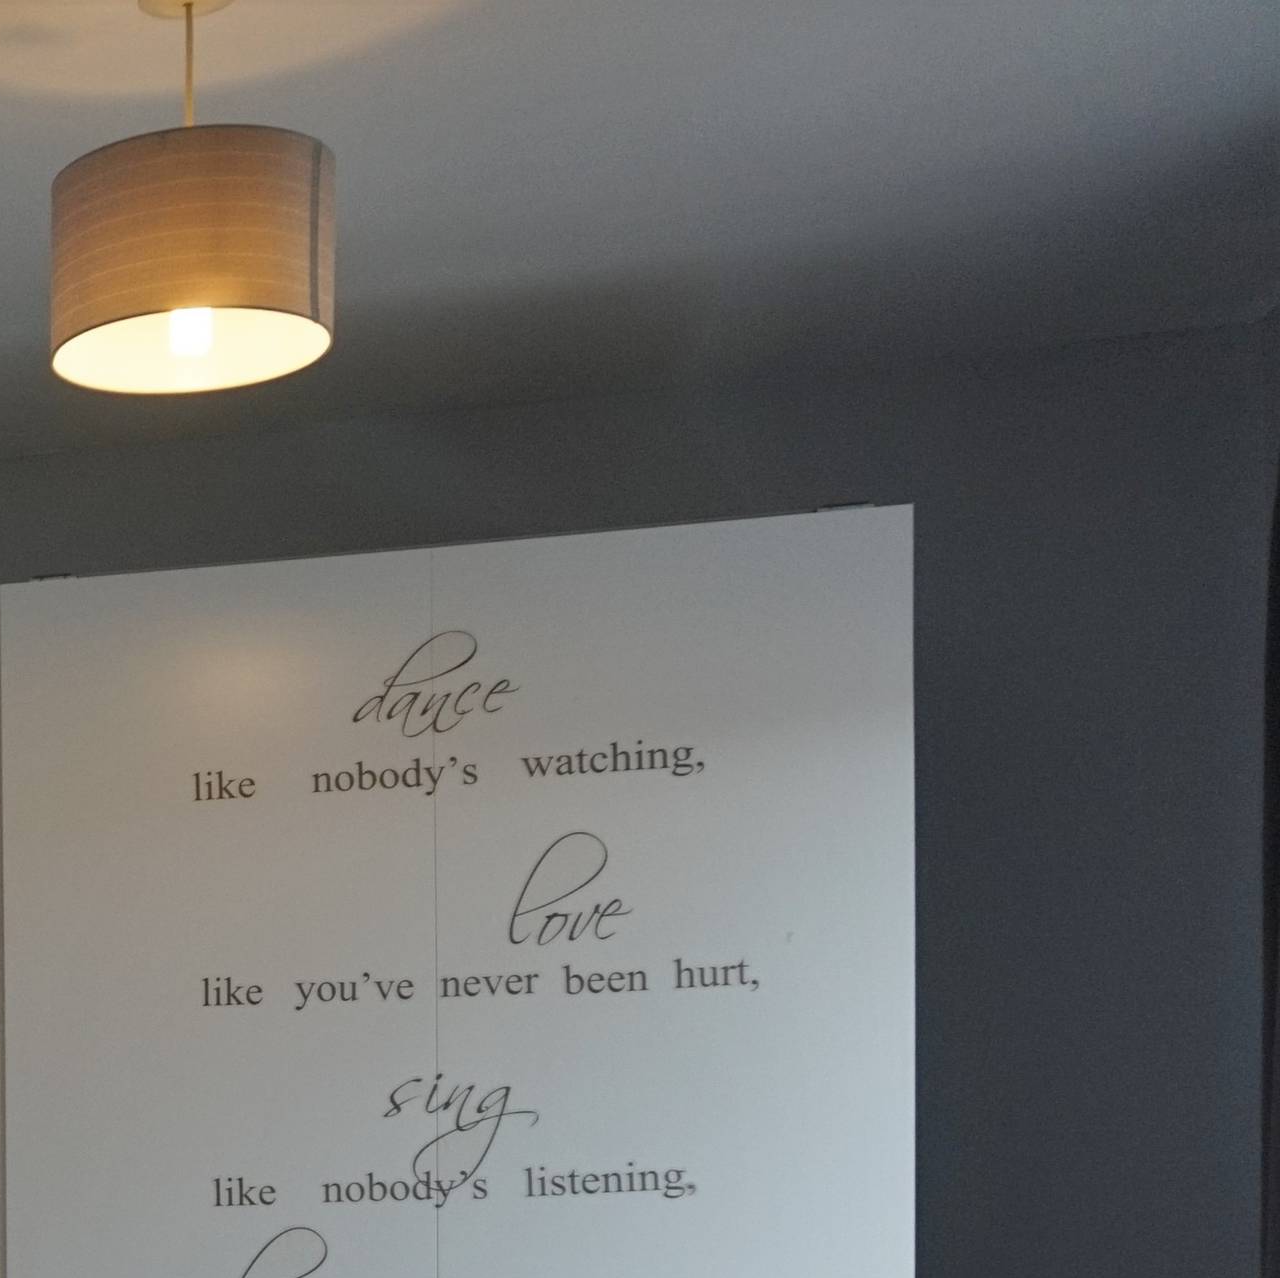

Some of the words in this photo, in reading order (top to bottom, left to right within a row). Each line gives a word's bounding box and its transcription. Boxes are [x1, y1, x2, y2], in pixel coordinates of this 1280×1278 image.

[352, 629, 520, 738] dance
[192, 771, 257, 801] like
[311, 755, 479, 797] nobody's
[520, 739, 706, 778] watching,
[507, 831, 633, 945] love
[201, 977, 264, 1007] like
[293, 971, 415, 1010] you've
[440, 969, 539, 1000] never
[563, 963, 649, 996] been
[673, 958, 761, 991] hurt,
[383, 1073, 539, 1191] sing
[212, 1177, 277, 1207] like
[321, 1171, 489, 1208] nobody's
[524, 1161, 697, 1199] listening,
